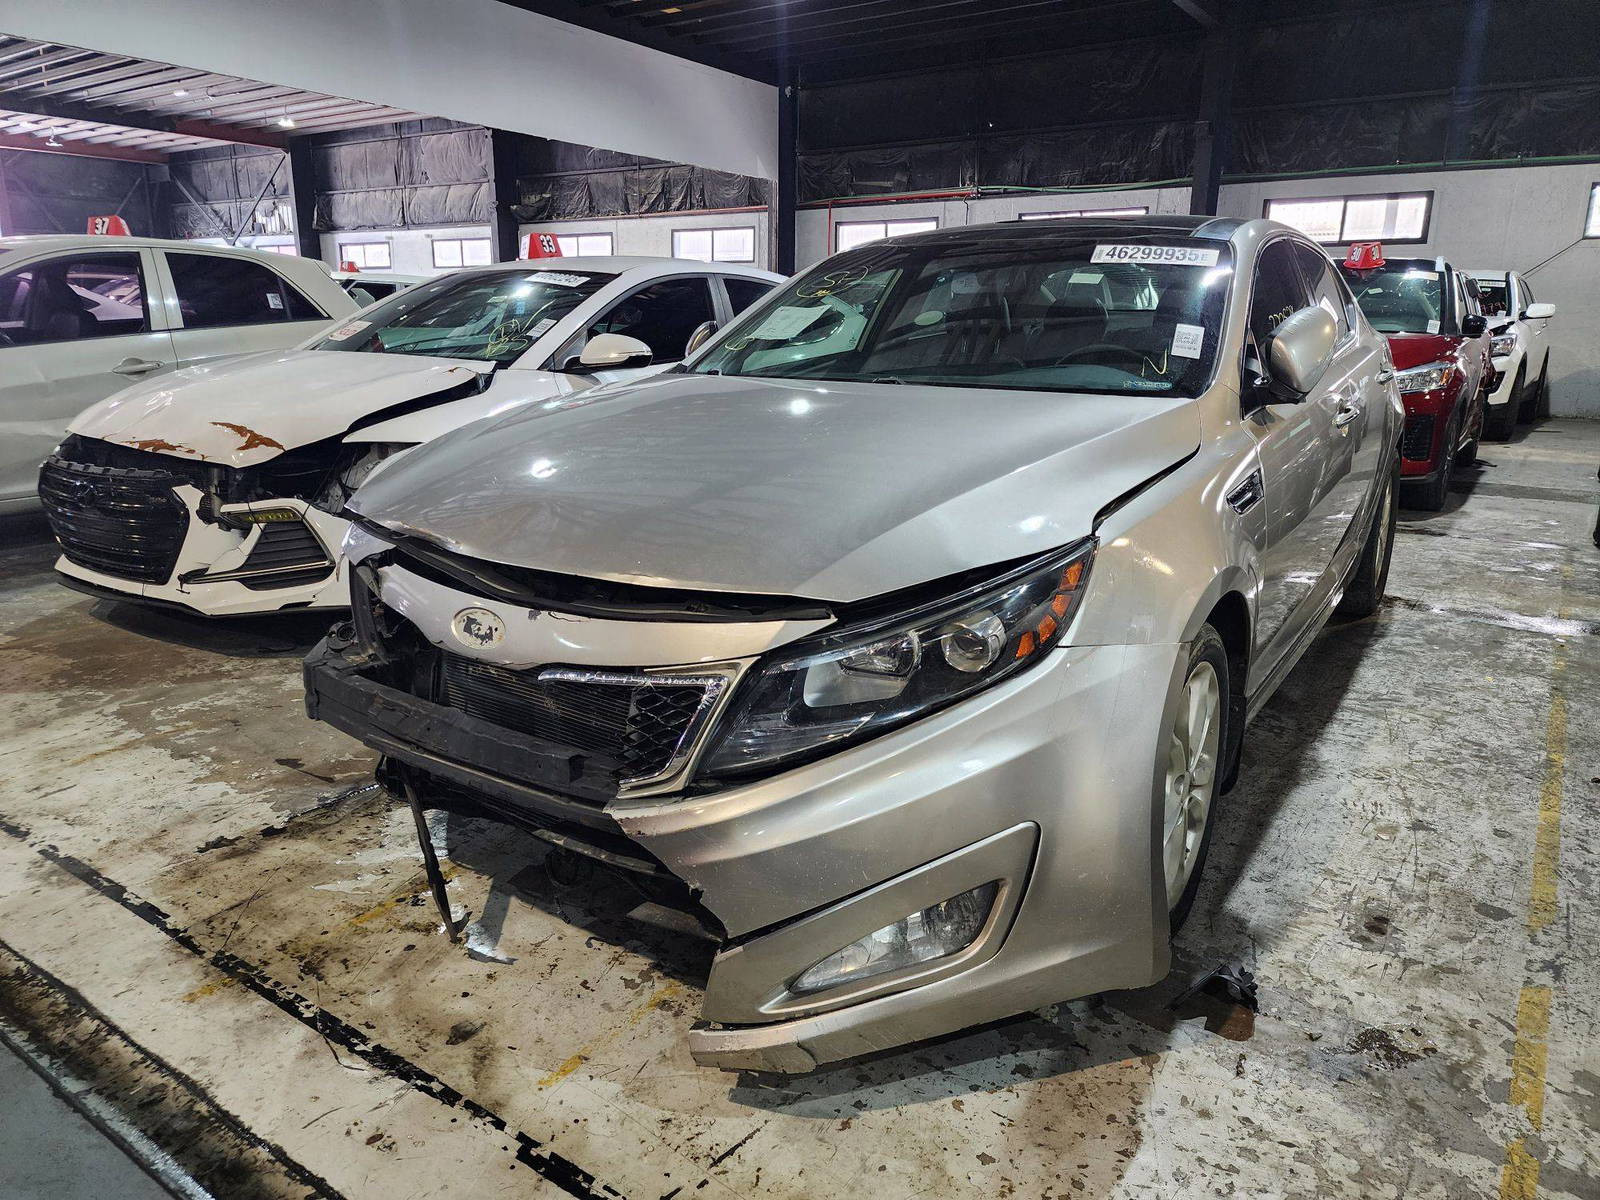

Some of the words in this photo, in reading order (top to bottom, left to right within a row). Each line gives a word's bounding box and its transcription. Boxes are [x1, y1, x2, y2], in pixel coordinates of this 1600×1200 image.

[95, 217, 109, 234] 37
[540, 235, 556, 253] 33
[1105, 246, 1199, 262] 46299935
[1351, 247, 1362, 261] 30
